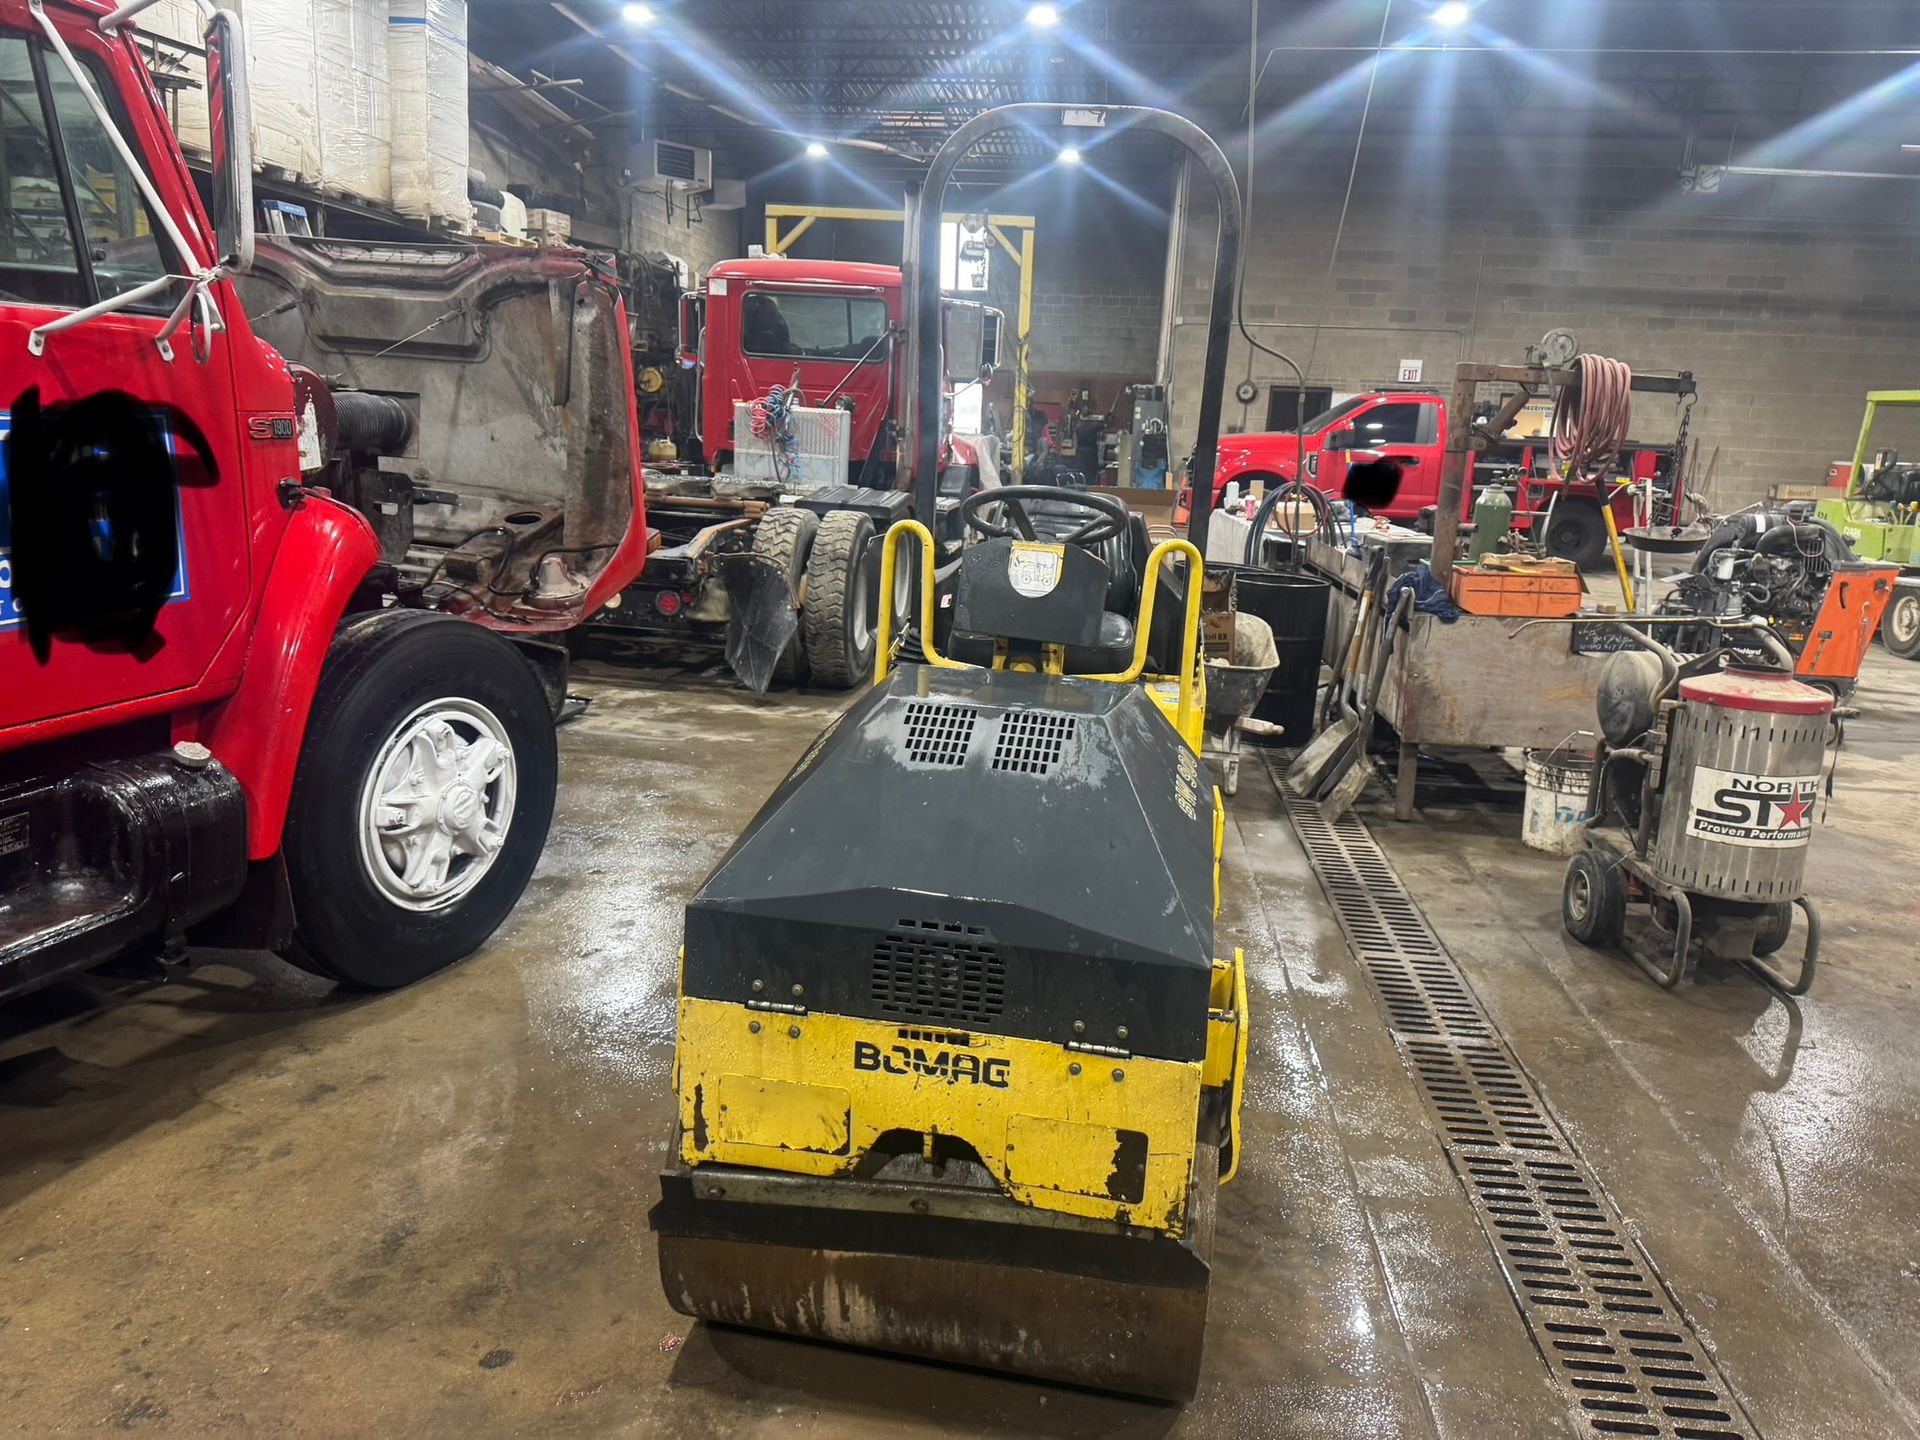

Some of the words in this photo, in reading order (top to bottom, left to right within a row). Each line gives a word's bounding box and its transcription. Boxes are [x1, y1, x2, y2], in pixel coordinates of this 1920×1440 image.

[1403, 369, 1418, 380] EXIT
[1732, 778, 1819, 793] NORTH
[1698, 820, 1746, 837] Proven
[854, 1040, 1011, 1089] BOMAG
